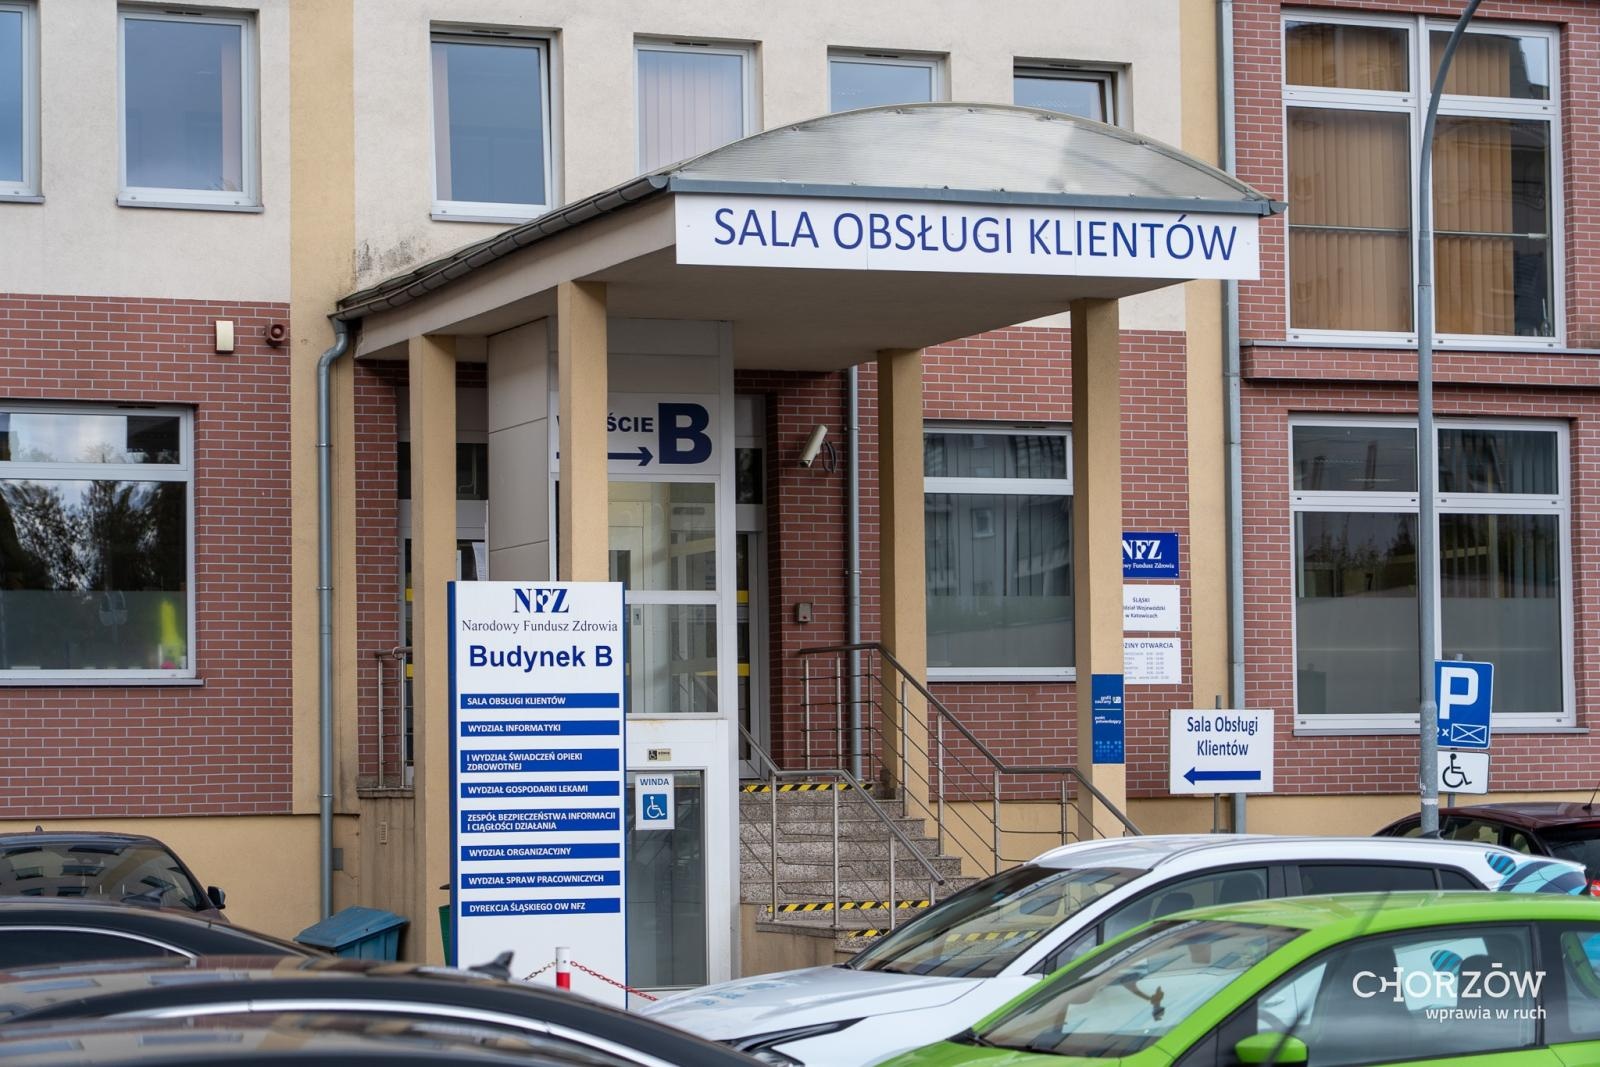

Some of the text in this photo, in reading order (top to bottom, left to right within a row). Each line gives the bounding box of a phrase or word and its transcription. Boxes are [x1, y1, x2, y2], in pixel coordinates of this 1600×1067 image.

[714, 208, 1238, 261] SALA OBSŁUGI KLIENTÓW
[658, 402, 712, 464] B
[1122, 540, 1162, 560] NFZ
[512, 588, 570, 613] NFZ
[462, 620, 618, 634] Narodowy Fundusz Zdrowia
[470, 645, 613, 673] Budynek B
[1439, 666, 1479, 720] P
[467, 696, 566, 706] SALA OBSŁUGI KLIENTÓW
[1187, 716, 1258, 736] Sala Obsługi
[1197, 740, 1249, 756] Klientów
[472, 753, 507, 761] WYDZIAŁ
[509, 752, 555, 761] ŚWIADCZEŃ
[468, 786, 504, 794] WYDZIAŁ
[468, 813, 496, 822] ZESPÓŁ
[498, 812, 566, 821] BEZPIECZEŃSTWA
[472, 822, 513, 832] CIĄGŁOŚCI
[469, 848, 571, 857] WYDZIAŁ ORGANIZACYJNY
[468, 876, 504, 885] WYDZIAŁ
[537, 874, 604, 883] PRACOWNICZYCH
[470, 904, 509, 912] DYREKCJA
[510, 902, 553, 913] ŚLĄSKIEGO
